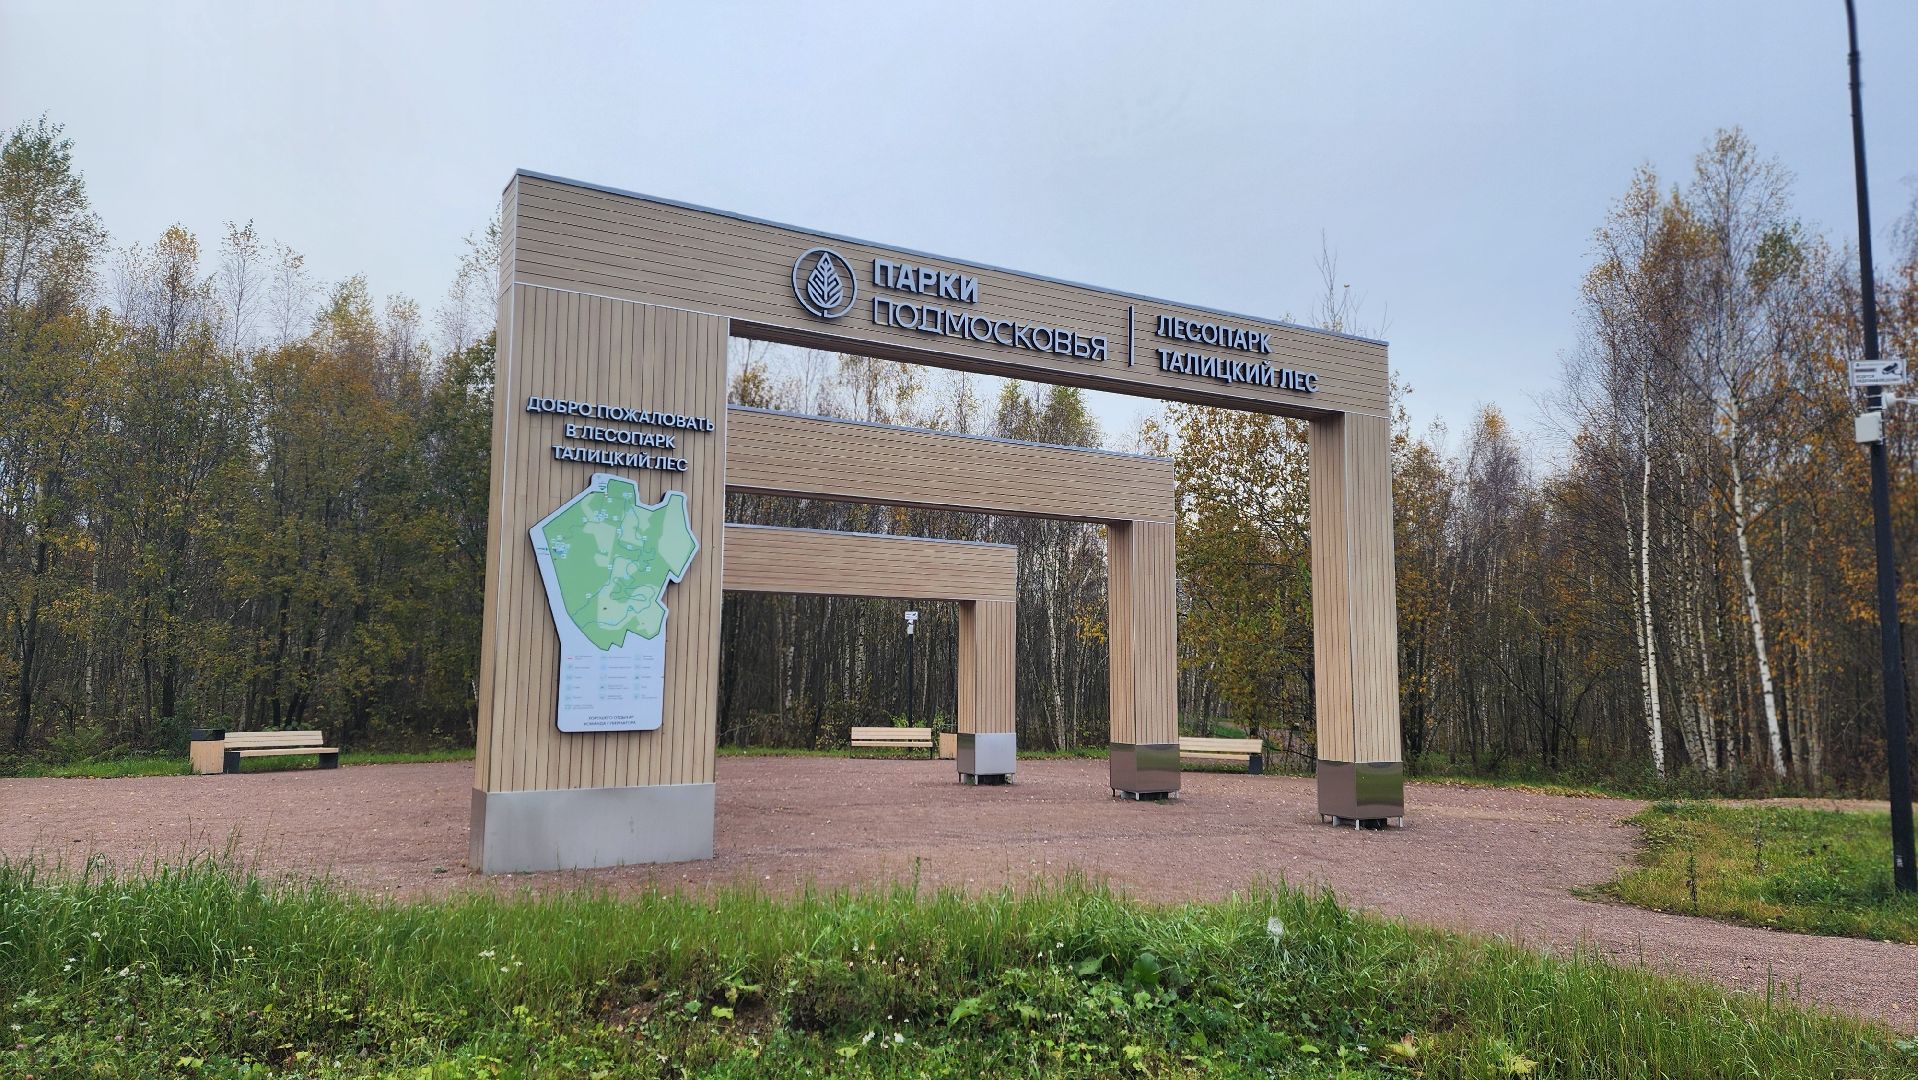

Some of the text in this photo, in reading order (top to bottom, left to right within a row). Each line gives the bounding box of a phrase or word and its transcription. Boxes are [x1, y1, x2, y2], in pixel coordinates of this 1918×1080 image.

[873, 258, 979, 303] ПАРКИ
[873, 296, 1109, 361] ПОДМОСКОВЬЯ
[1156, 314, 1272, 354] ЛЕСОПАРК
[1157, 347, 1320, 393] ТАЛИЦКИЙ ЛЕС
[526, 396, 715, 433] ДОБРО ПОЖАЛОВАТЬ
[565, 423, 676, 449] В ЛЕСОПАРК
[552, 445, 689, 473] ТАЛИЦКИЙ ЛЕС
